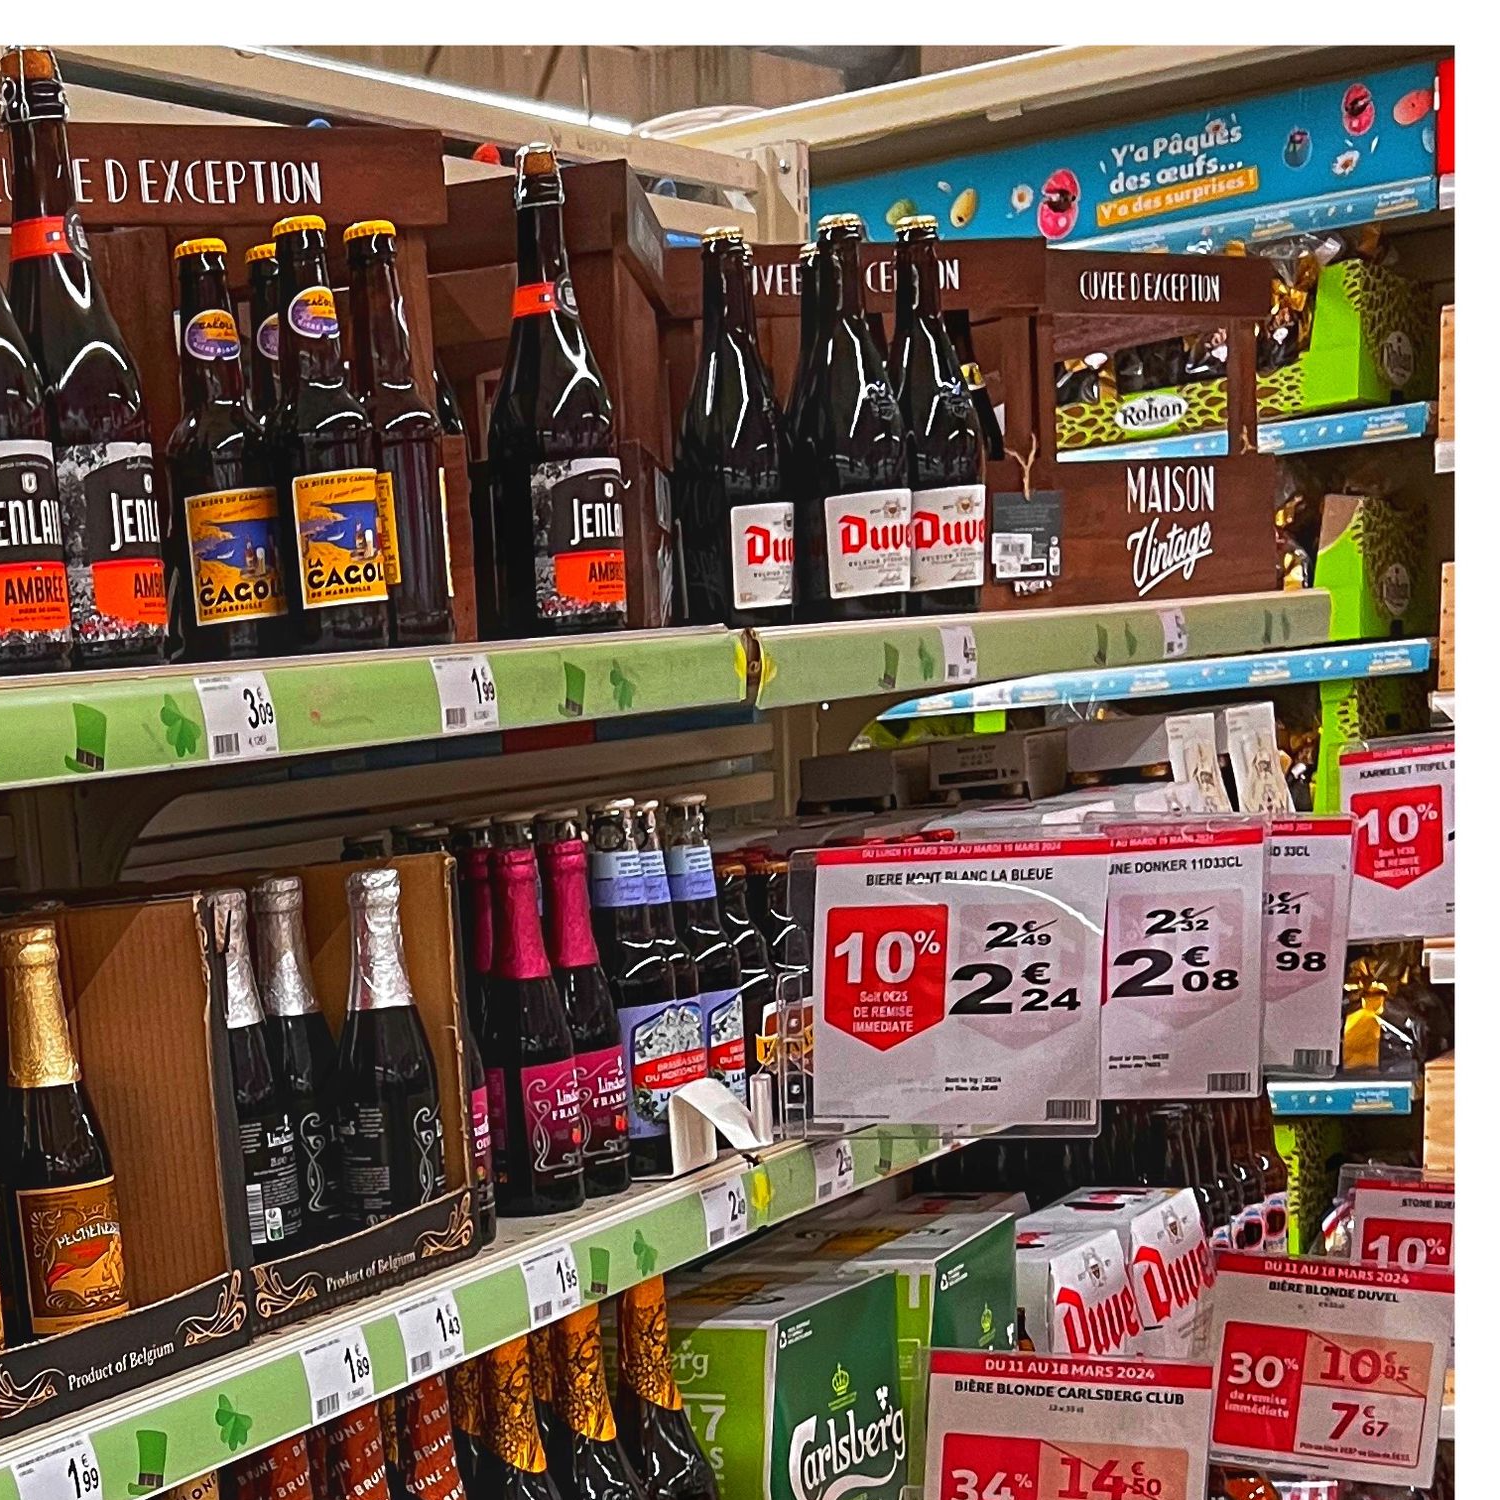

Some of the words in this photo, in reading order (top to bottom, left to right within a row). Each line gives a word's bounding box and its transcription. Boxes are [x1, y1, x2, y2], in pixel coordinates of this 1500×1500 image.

[1111, 144, 1148, 167] Y'a
[1153, 125, 1242, 159] Pâques
[103, 159, 129, 197] D
[137, 158, 322, 205] EXCEPTION
[1110, 172, 1151, 194] des
[1133, 195, 1162, 212] des
[1165, 176, 1245, 205] surprises
[1080, 271, 1126, 301] CUVEE
[1129, 271, 1141, 301] D
[1143, 272, 1221, 303] EXCEPTION
[1121, 400, 1184, 426] Rohan
[1126, 466, 1216, 514] MAISON
[308, 558, 323, 570] LA
[1127, 518, 1213, 586] Vintage
[308, 566, 385, 590] CAGOL
[866, 872, 903, 886] BIERE
[991, 868, 1008, 882] LA
[1011, 867, 1053, 880] BLEUE
[1135, 859, 1188, 874] DONKER
[853, 1006, 868, 1018] DE
[871, 1006, 913, 1018] REMISE
[852, 1021, 914, 1033] IMMEDIATE
[325, 1267, 364, 1292] Product
[365, 1262, 377, 1278] of
[378, 1250, 416, 1276] Belgium
[1269, 1279, 1303, 1294] BIÈRE
[1305, 1284, 1355, 1298] BLONDE
[1357, 1289, 1400, 1303] DUVEL
[67, 1363, 113, 1392] Product
[115, 1354, 129, 1374] of
[130, 1339, 175, 1372] Belgium
[985, 1359, 1005, 1371] DU
[1009, 1361, 1023, 1373] 11
[1027, 1362, 1049, 1374] AU
[1069, 1364, 1114, 1378] MARS
[1116, 1366, 1155, 1380] 2024
[954, 1379, 993, 1394] BIÈRE
[996, 1384, 1055, 1398] BLONDE
[1057, 1387, 1143, 1403] CARLSBERG
[1146, 1391, 1185, 1405] CLUB
